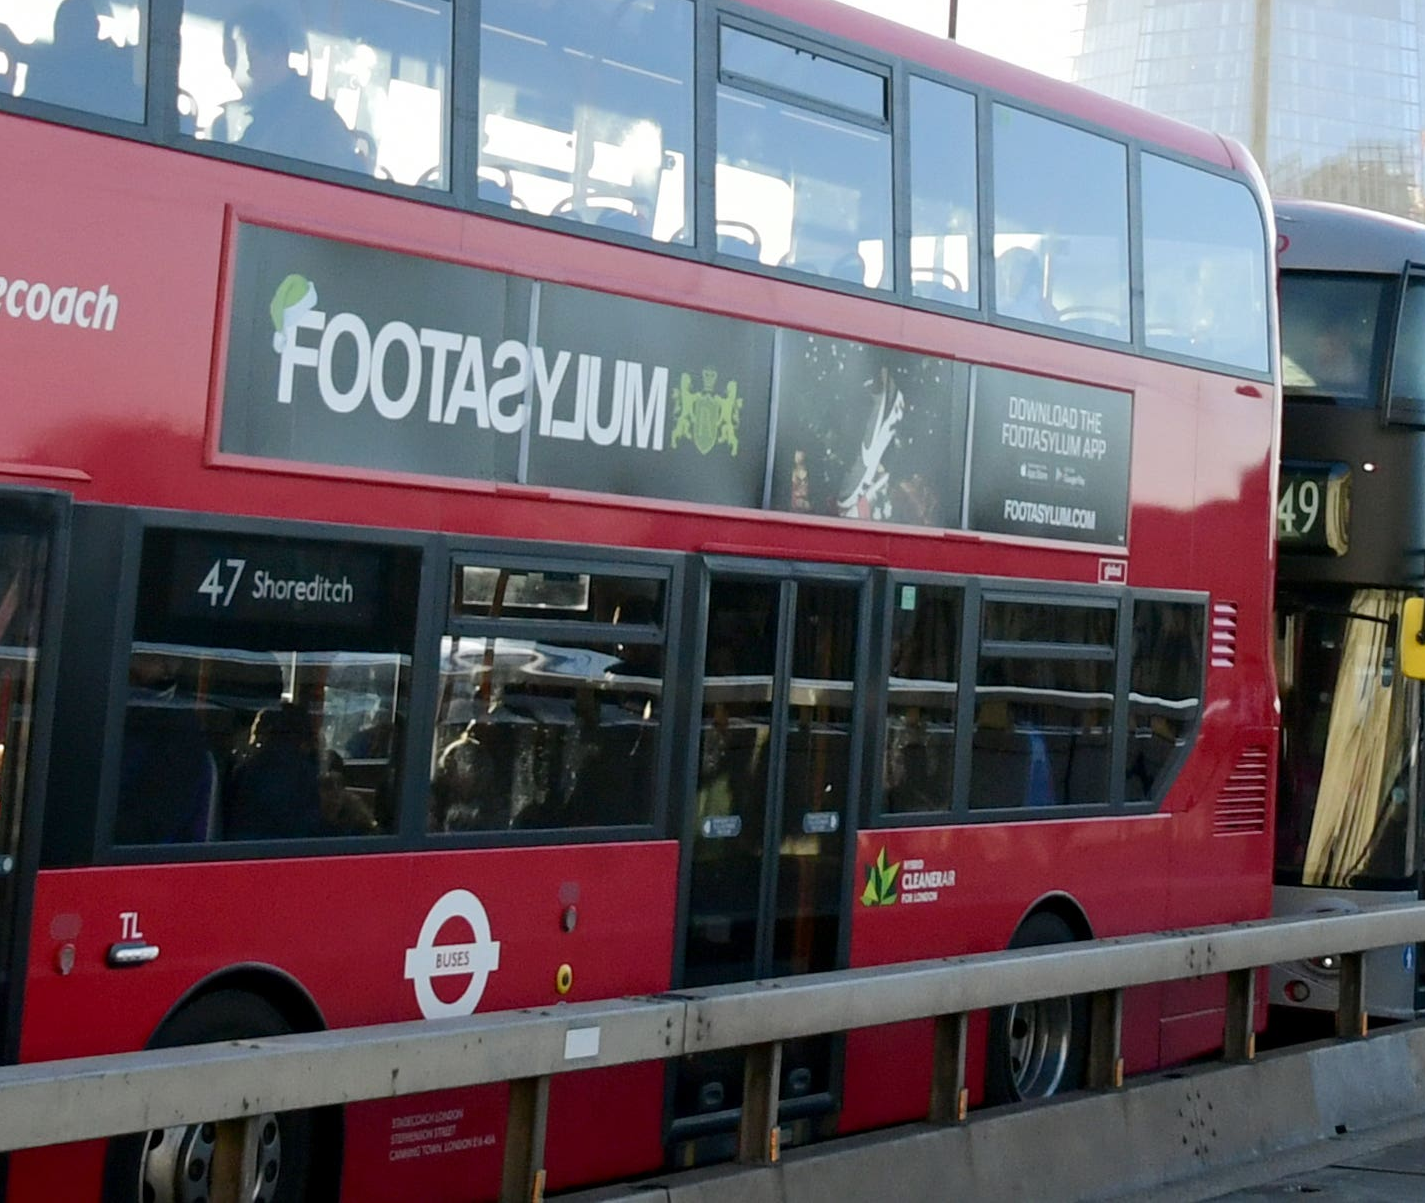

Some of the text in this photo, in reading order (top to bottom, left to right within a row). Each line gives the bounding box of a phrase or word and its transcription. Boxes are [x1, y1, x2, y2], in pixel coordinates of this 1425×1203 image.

[277, 309, 669, 451] FOOTASYLUM
[1008, 396, 1103, 435] DOWNLOAD THE
[1001, 422, 1107, 460] FOOTASYLUM APP
[1003, 499, 1096, 530] FOOTASYLUM.COM
[198, 558, 354, 606] 47 Shoreditch
[119, 911, 143, 939] TL
[435, 951, 470, 968] BUSES
